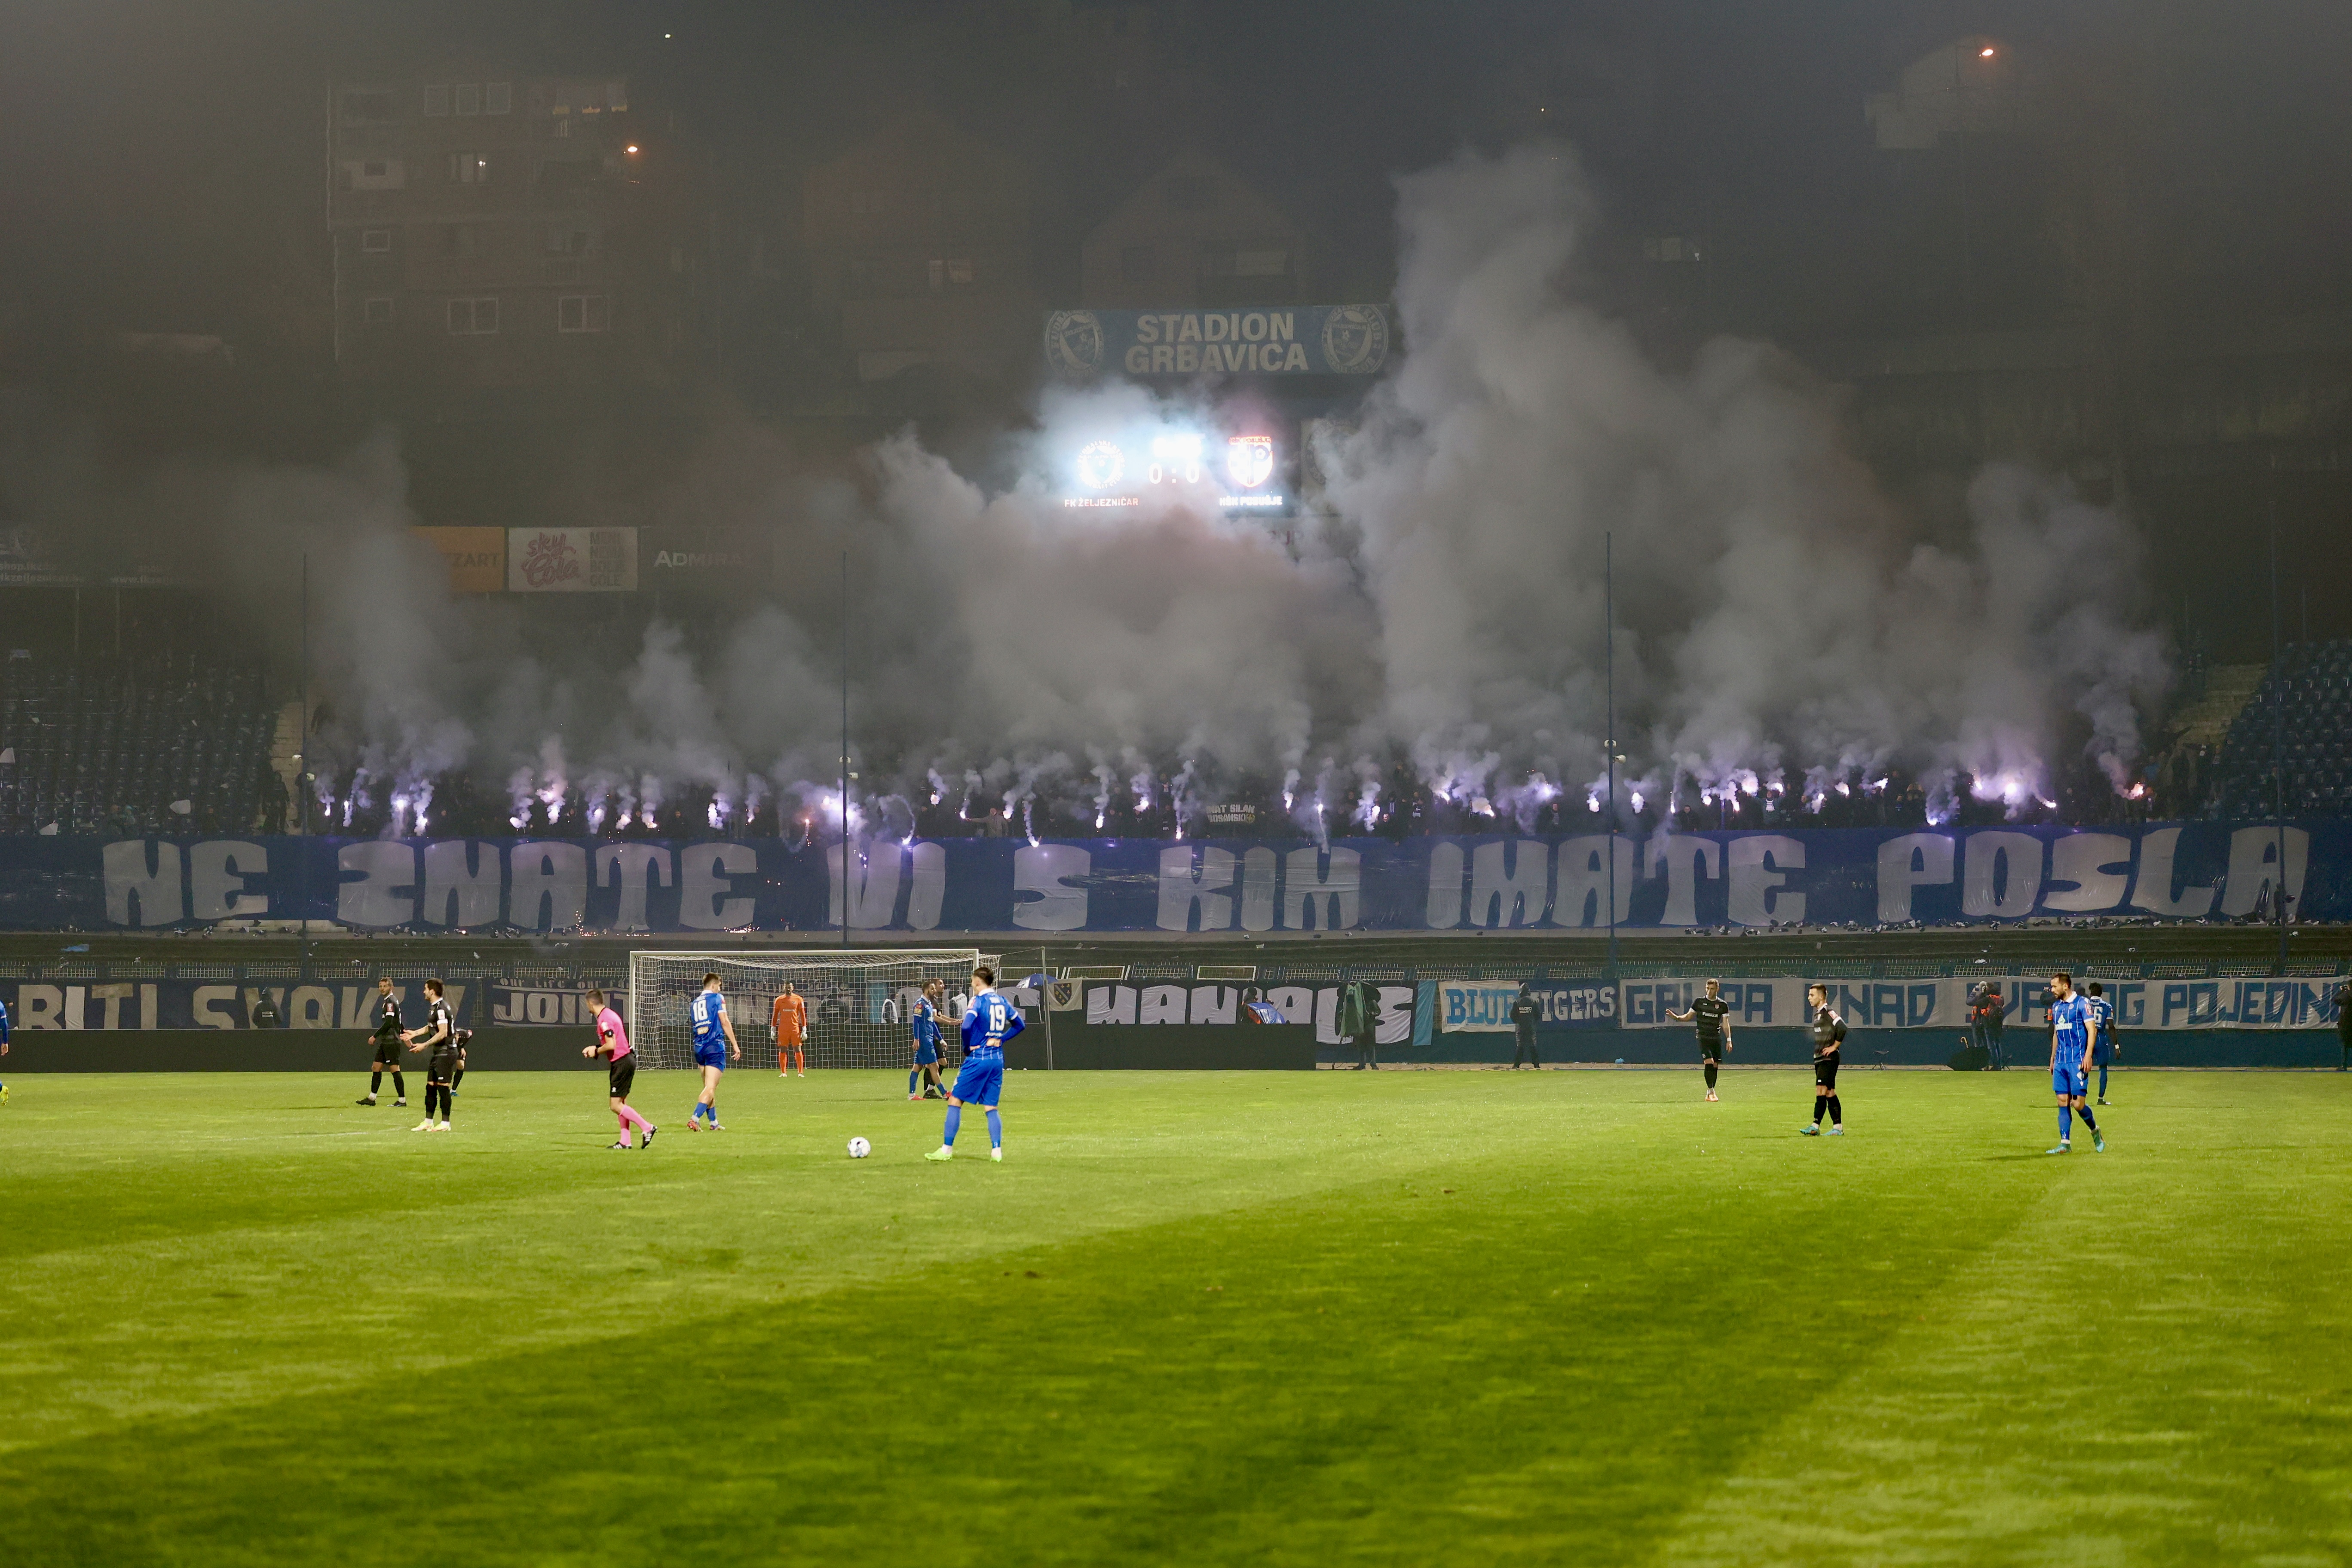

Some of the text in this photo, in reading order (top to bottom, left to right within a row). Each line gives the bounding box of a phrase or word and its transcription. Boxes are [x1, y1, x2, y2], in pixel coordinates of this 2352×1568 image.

[1137, 313, 1293, 343] STADION
[1125, 343, 1309, 373] GRBAVICA
[1064, 496, 1138, 507] FK ŽELJEZNIČAR
[653, 550, 743, 568] ADMIRA
[103, 826, 2309, 931] NE ZNATE VI S KIM IMATE POSLA
[18, 983, 157, 1029] RITI
[693, 999, 708, 1022] 18
[989, 1004, 1005, 1031] 19
[2092, 1006, 2103, 1023] 6
